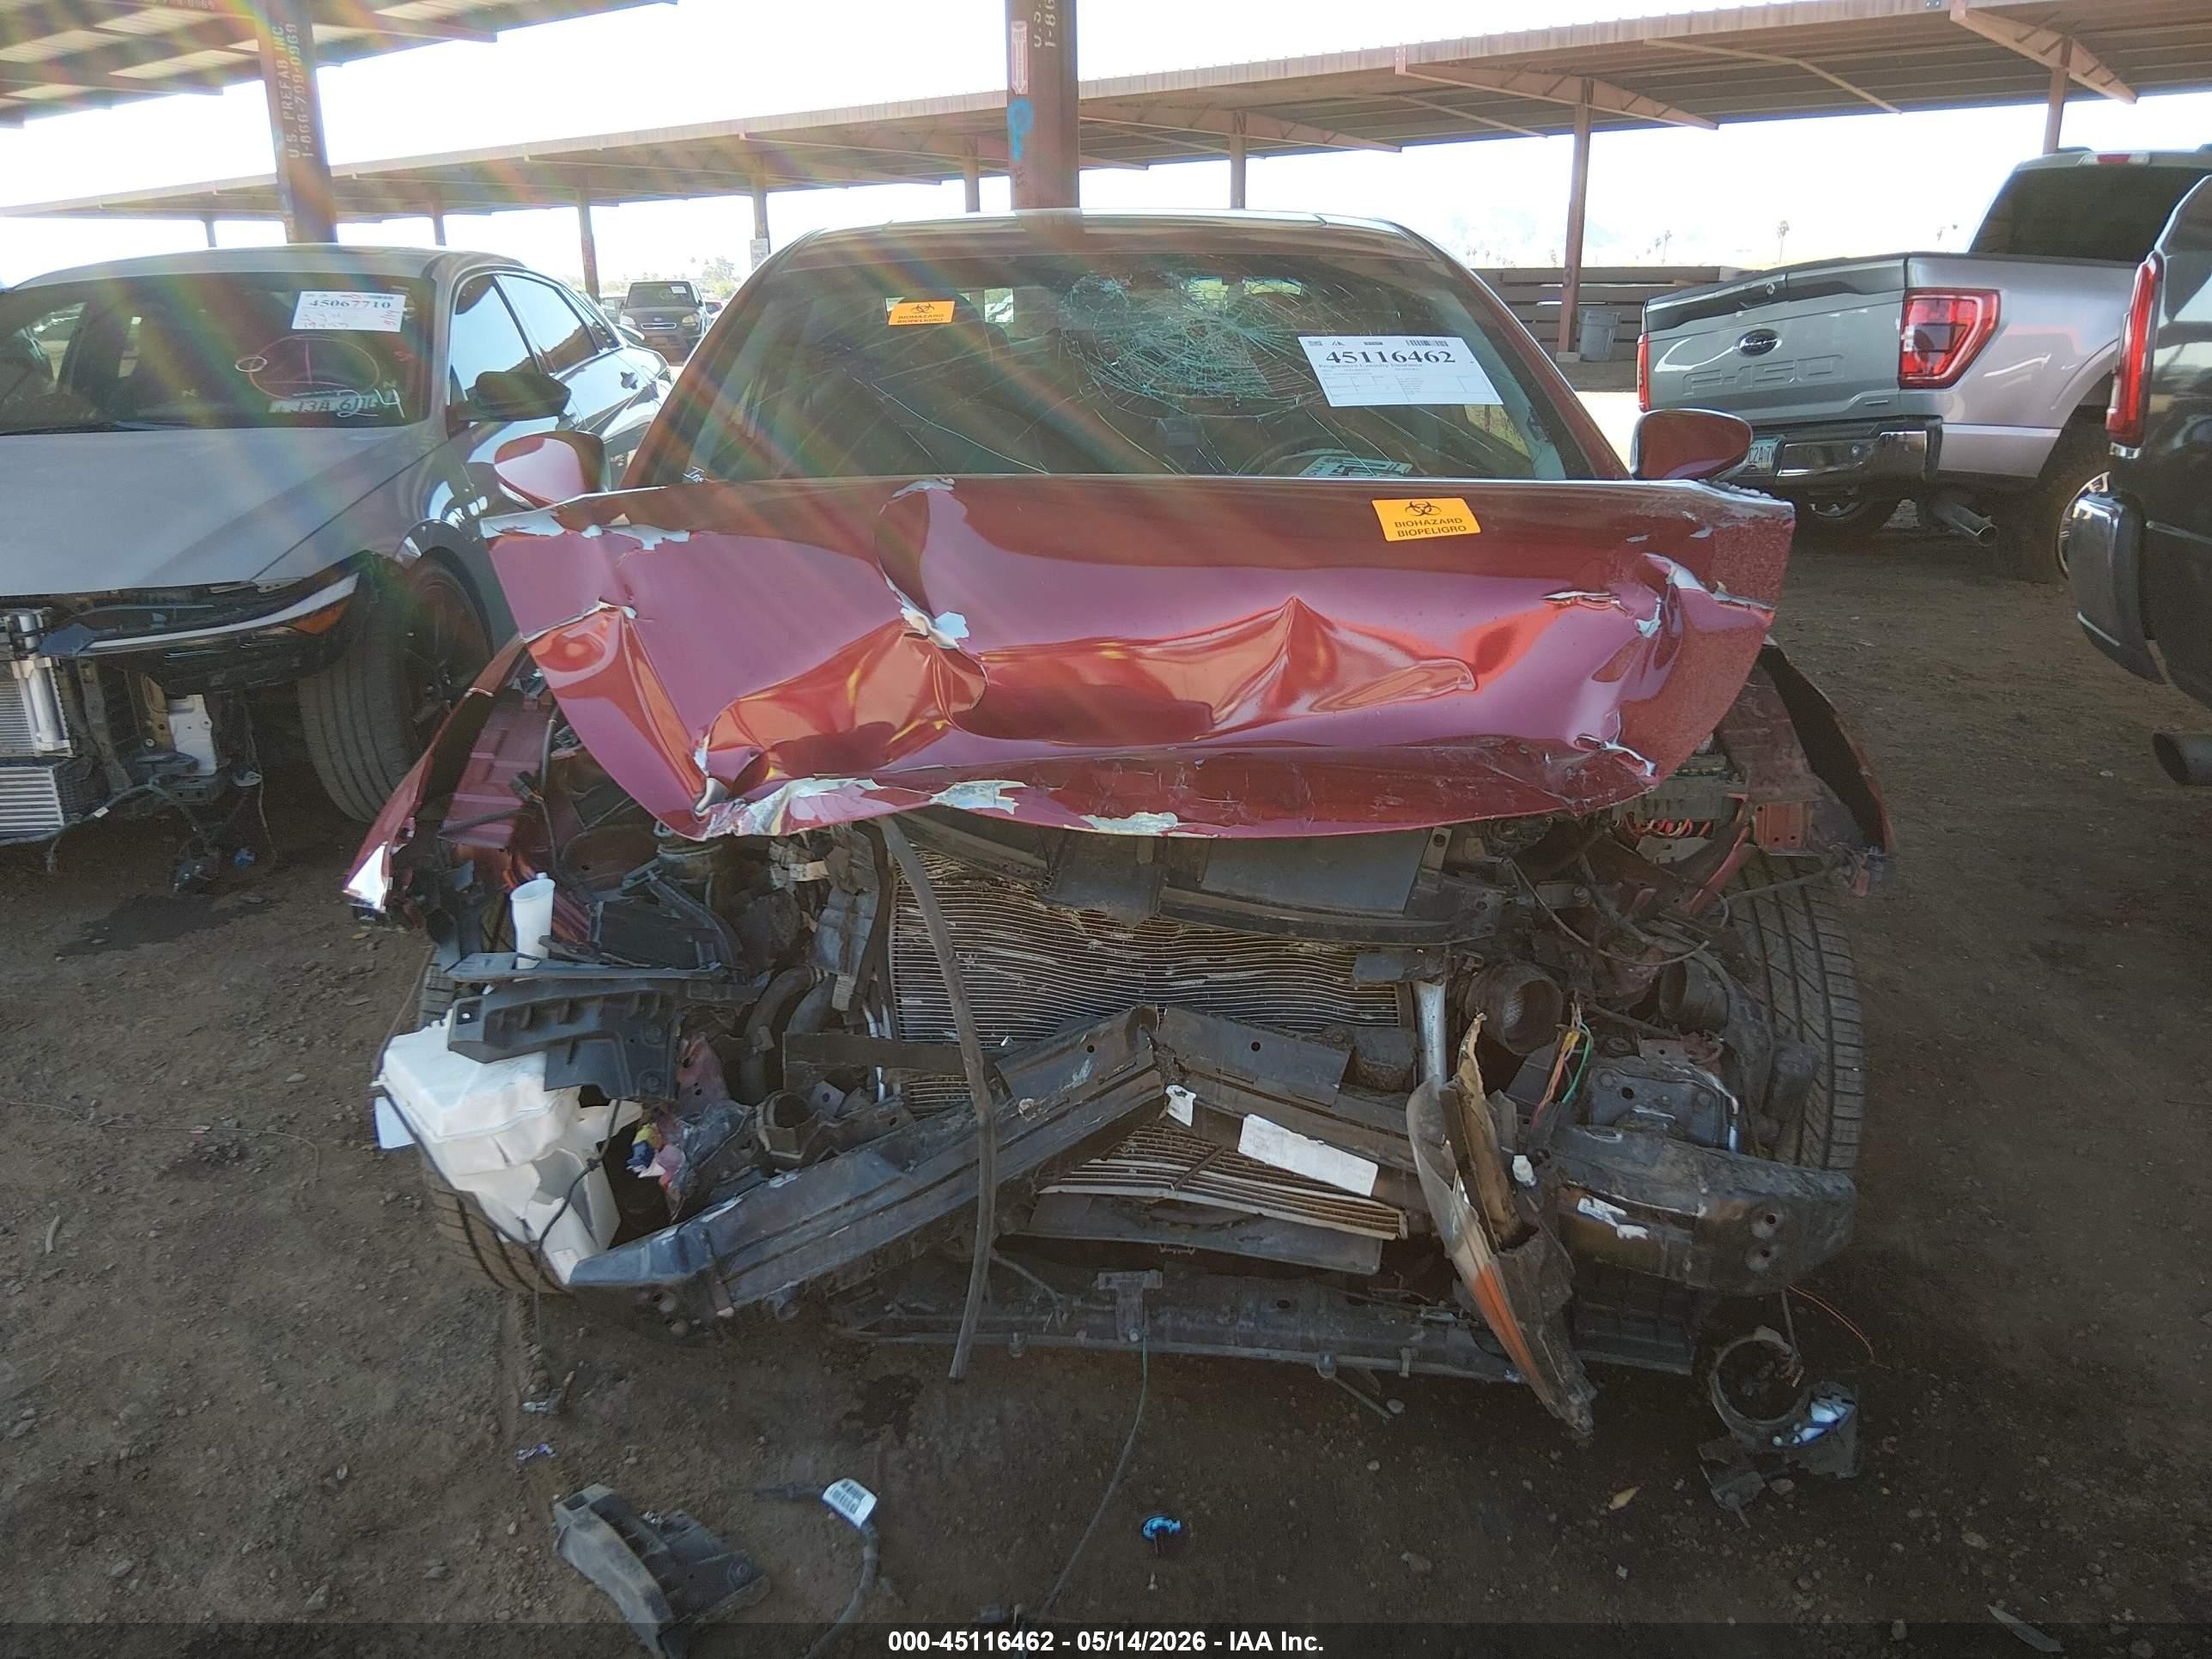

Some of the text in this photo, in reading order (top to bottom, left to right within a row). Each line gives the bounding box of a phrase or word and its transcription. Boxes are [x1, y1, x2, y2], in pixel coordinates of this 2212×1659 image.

[276, 59, 296, 120] PREFAB
[308, 299, 392, 309] 45067710
[1326, 349, 1455, 364] 45116462
[1682, 354, 1844, 399] F-150
[1394, 517, 1463, 528] BIOHAZARD
[1396, 525, 1468, 538] BIOPELIGRO
